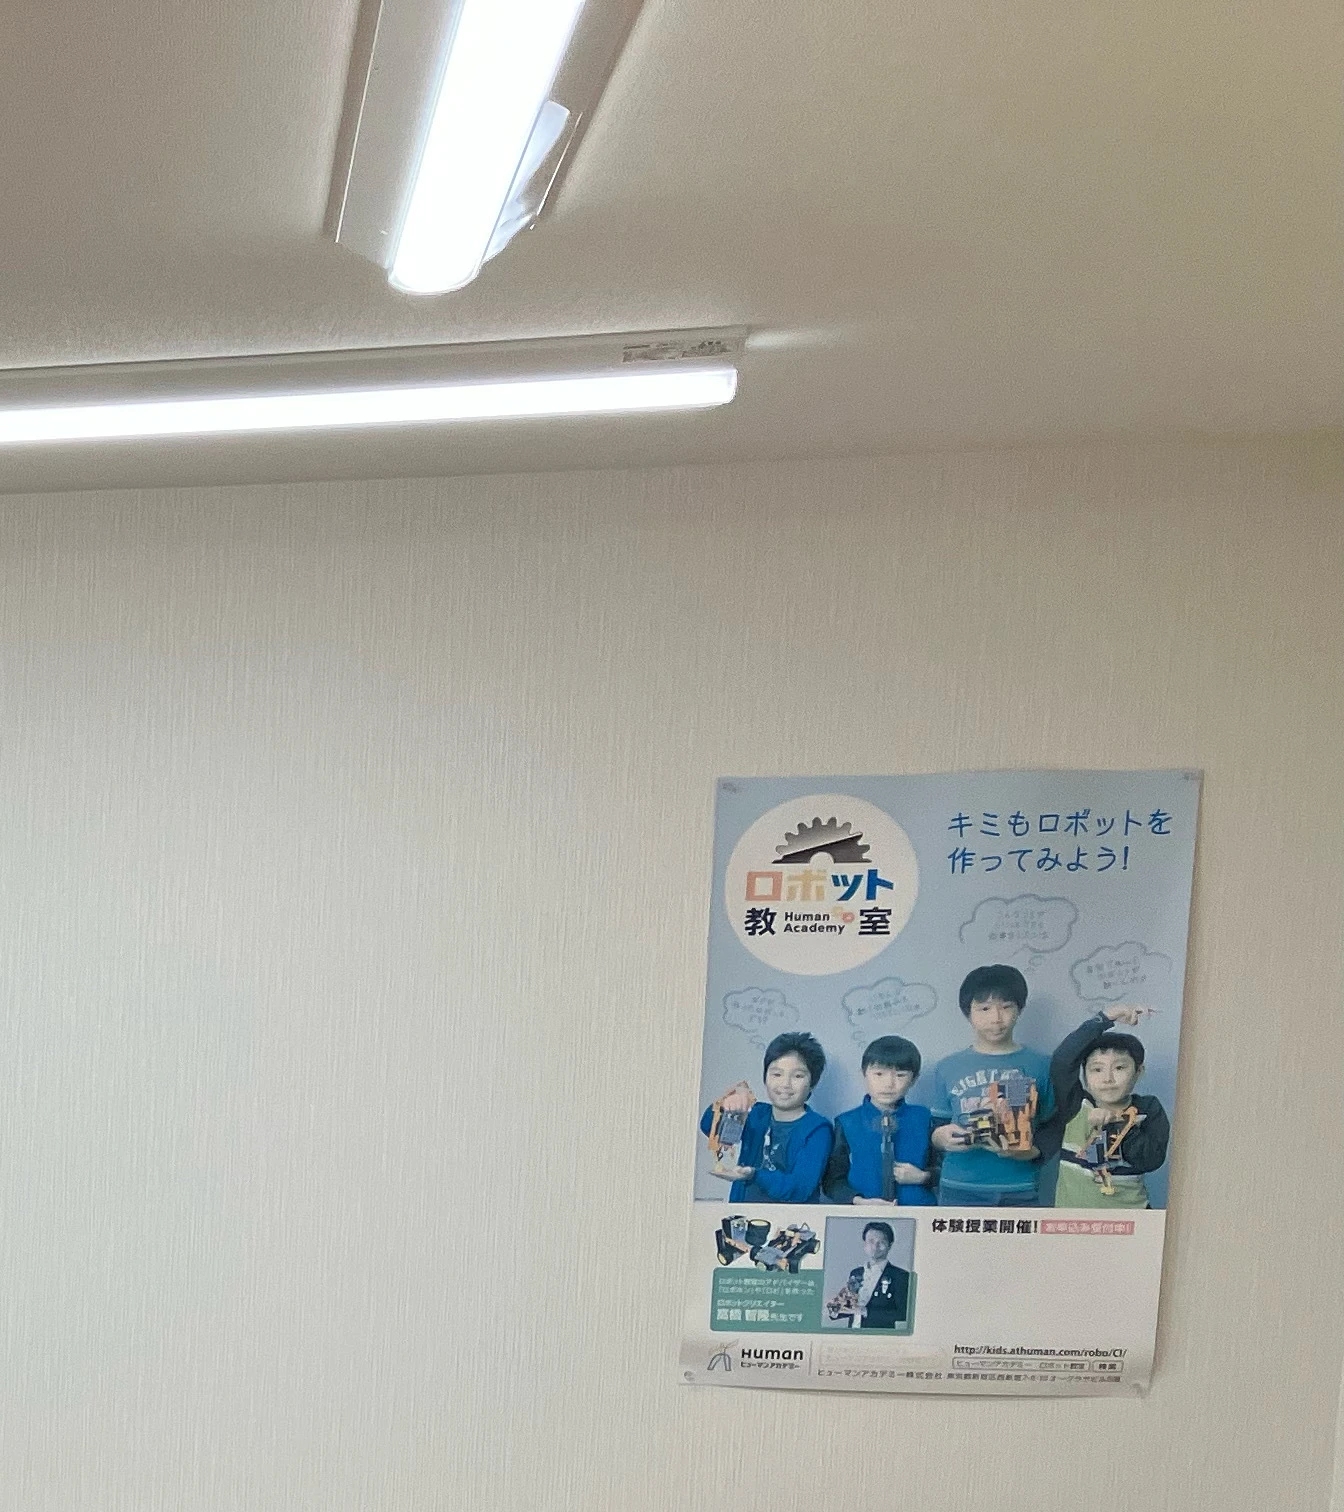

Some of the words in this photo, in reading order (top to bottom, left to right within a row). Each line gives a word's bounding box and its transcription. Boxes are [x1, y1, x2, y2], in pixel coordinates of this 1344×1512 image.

[947, 808, 1173, 838] キミもロボットを
[745, 868, 894, 902] ロボット
[744, 907, 777, 937] 教
[858, 907, 892, 936] 室
[784, 911, 830, 923] Human
[783, 922, 846, 935] Academy
[741, 1349, 804, 1361] Human
